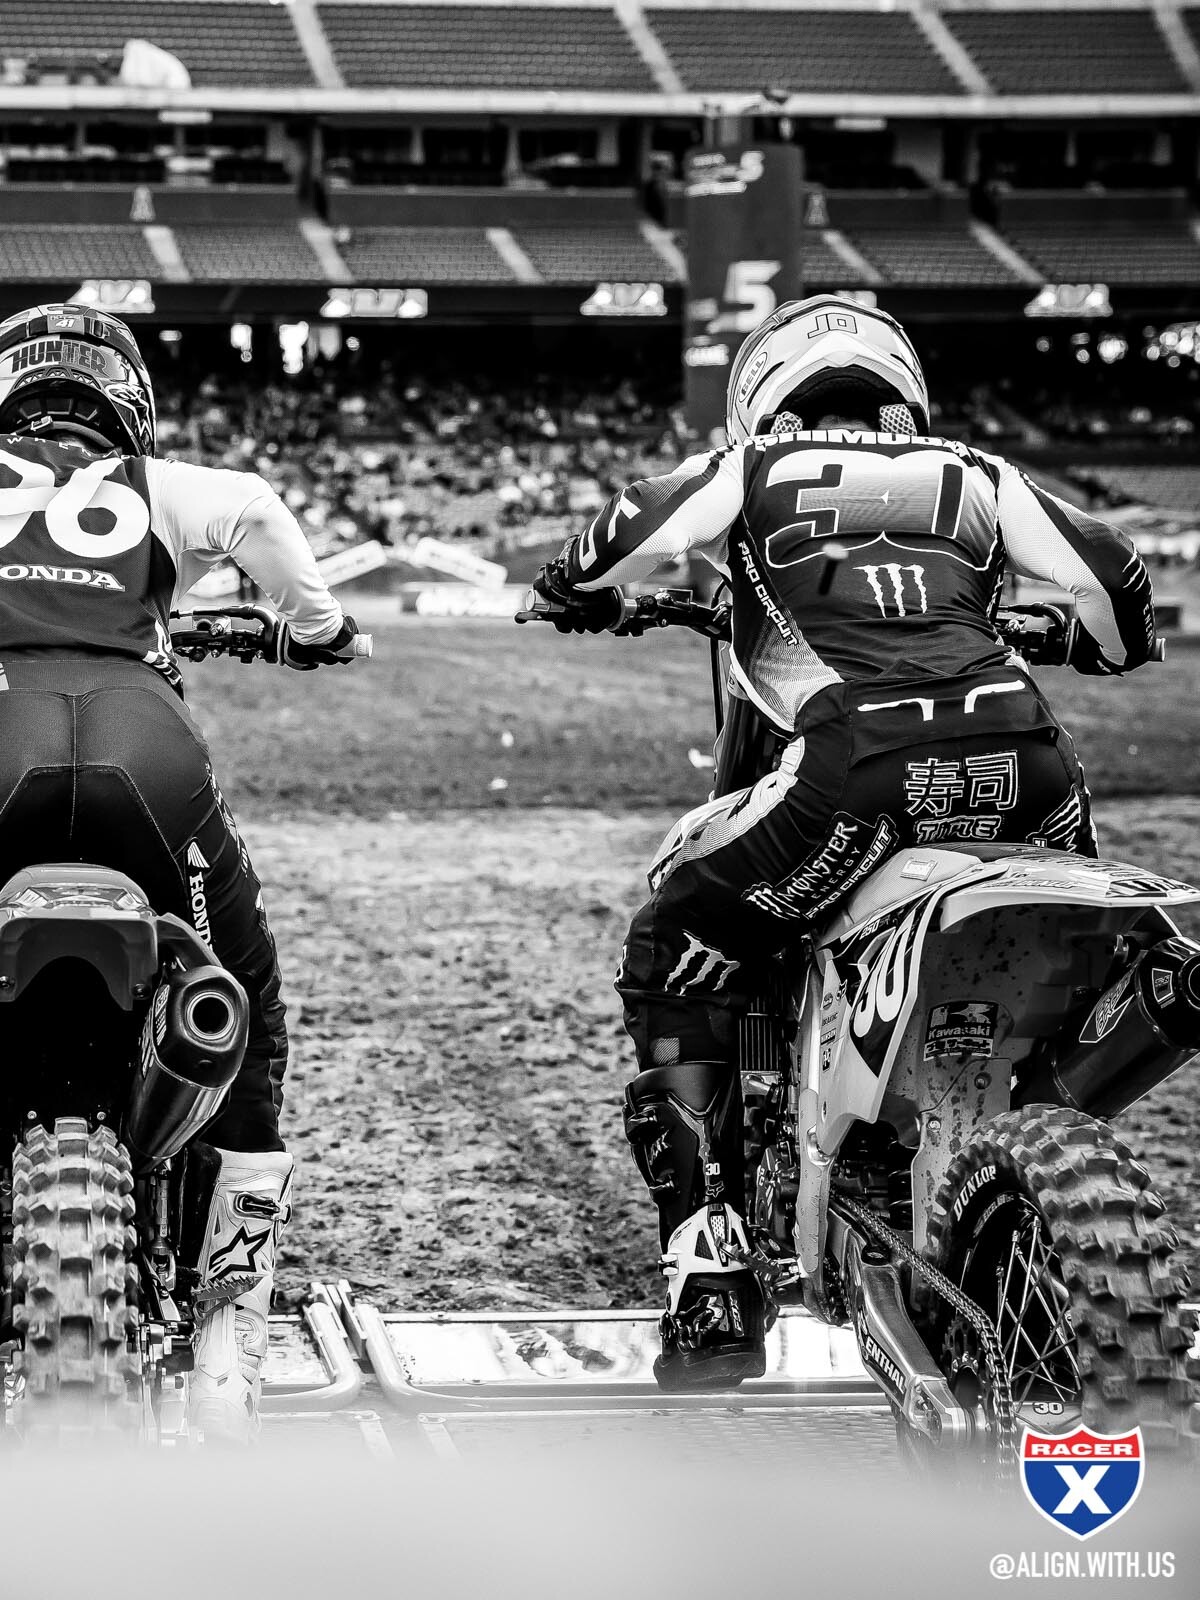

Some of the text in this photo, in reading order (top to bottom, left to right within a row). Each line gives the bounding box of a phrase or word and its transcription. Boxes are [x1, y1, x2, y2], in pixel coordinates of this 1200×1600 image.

[807, 312, 858, 339] JO
[11, 340, 109, 378] HUNTER
[741, 360, 765, 397] BELL
[765, 449, 999, 570] 30
[738, 541, 798, 645] PRO CIRCUIT
[905, 750, 1018, 816] 寿司
[777, 821, 858, 902] MONSTER
[811, 846, 861, 899] ENERGY
[840, 822, 892, 891] CIRCUIT
[189, 871, 214, 950] HOND
[853, 908, 916, 1038] 30
[705, 1163, 720, 1176] 30
[953, 1165, 997, 1222] DUNLOP
[1033, 1402, 1064, 1415] 30
